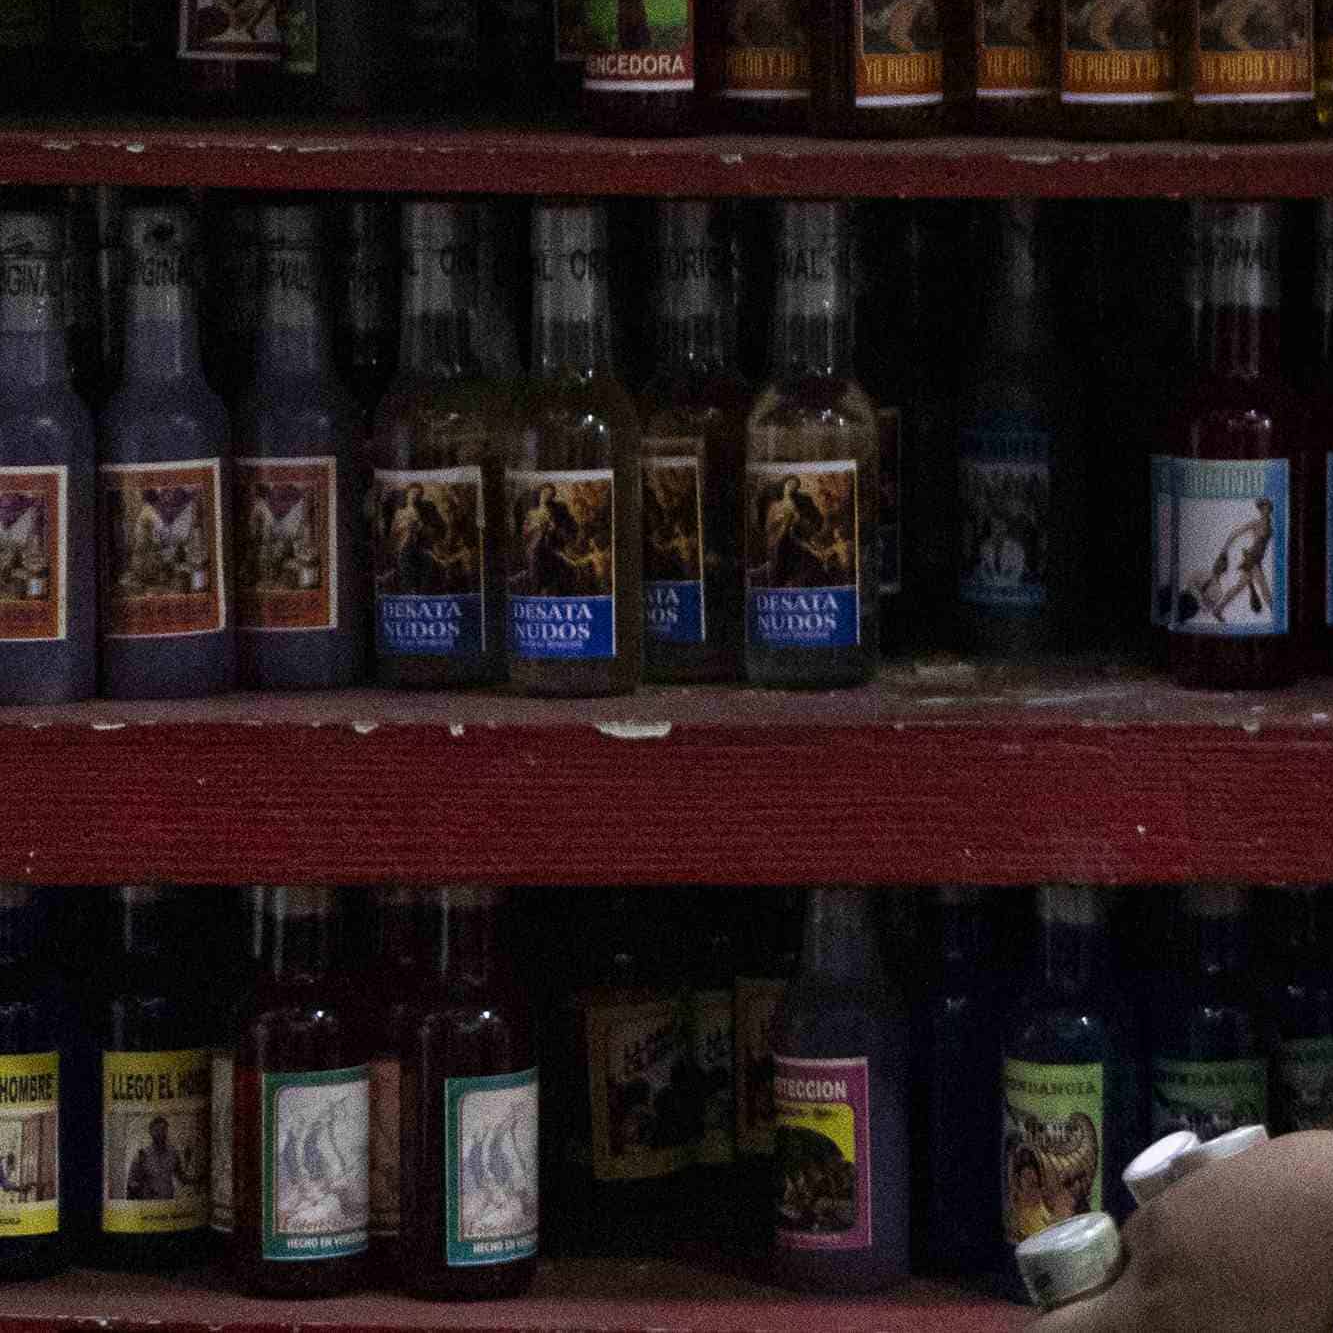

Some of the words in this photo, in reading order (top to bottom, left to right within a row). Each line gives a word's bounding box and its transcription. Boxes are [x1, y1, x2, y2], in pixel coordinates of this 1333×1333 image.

[383, 600, 463, 619] DESATA
[512, 602, 593, 621] DESATA
[756, 592, 839, 612] DESATA
[384, 620, 460, 639] NUDOS
[512, 621, 591, 640] NUDOS
[757, 611, 837, 631] NUDOS
[0, 1074, 53, 1104] HOMBRE
[112, 1073, 154, 1102] LLEGO
[156, 1073, 175, 1100] EL
